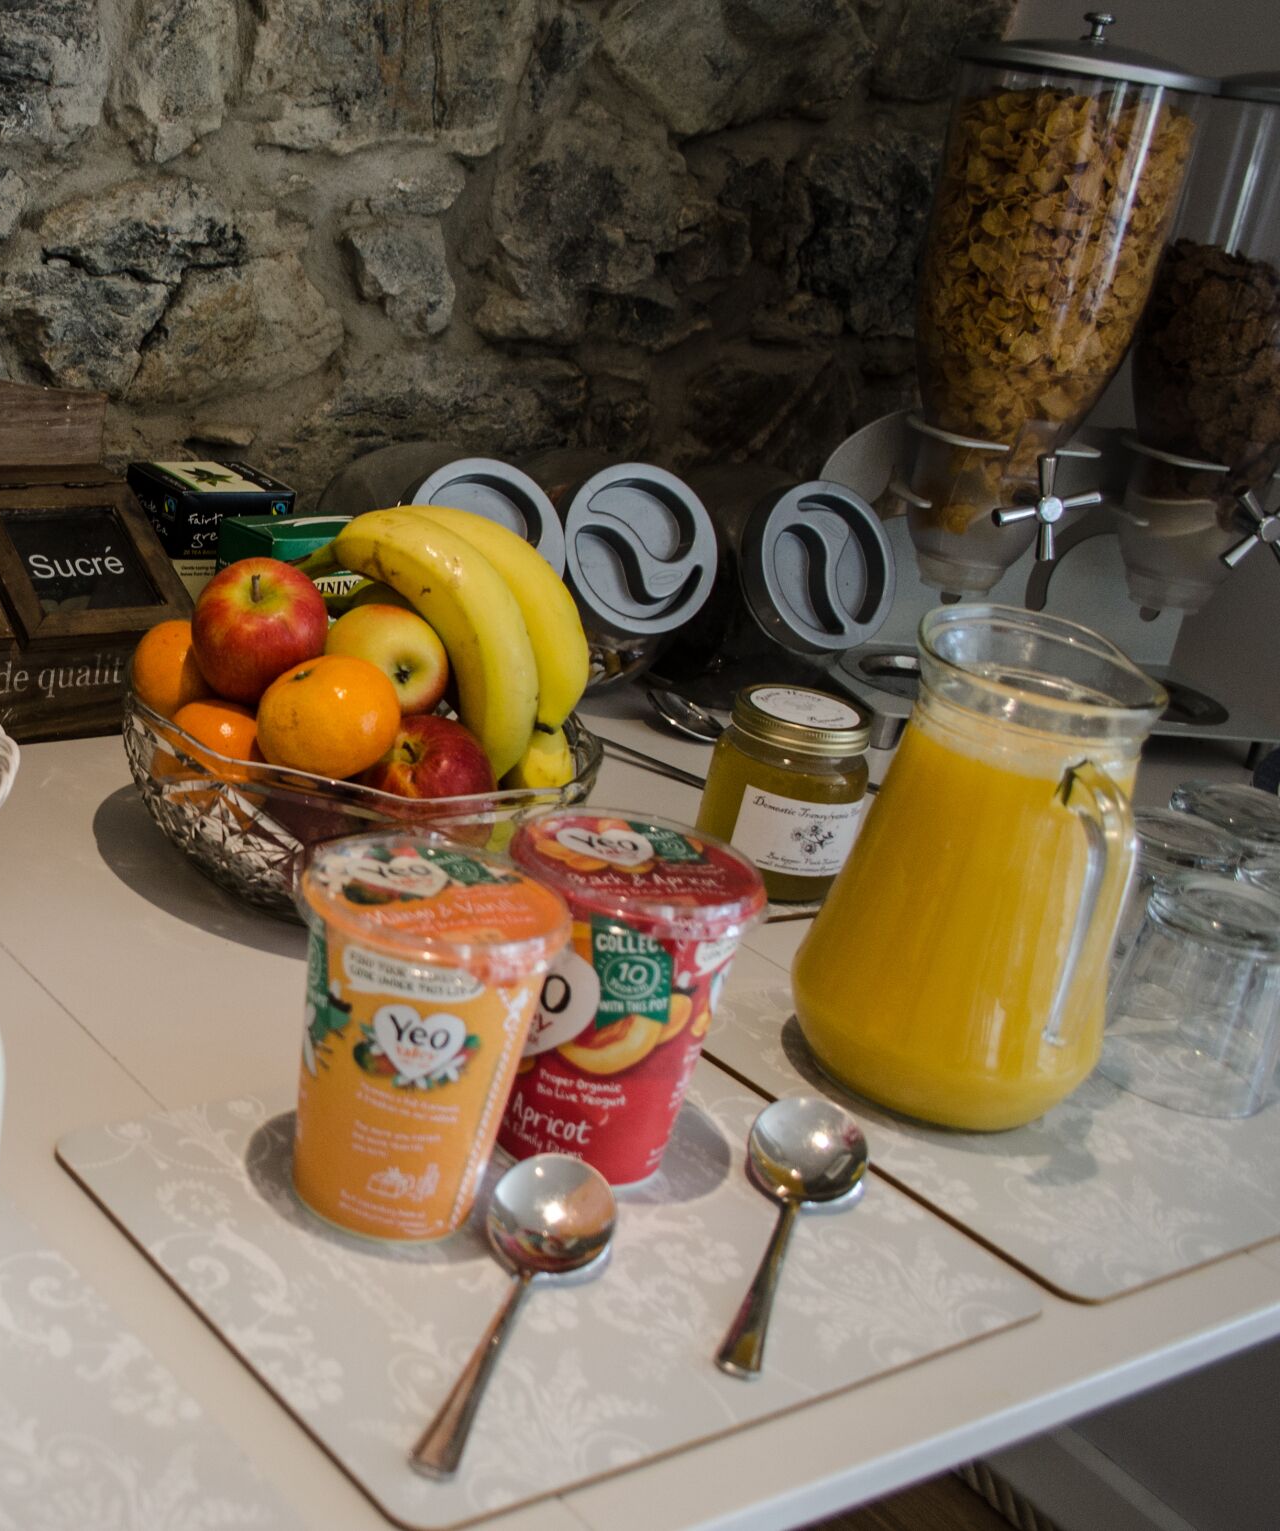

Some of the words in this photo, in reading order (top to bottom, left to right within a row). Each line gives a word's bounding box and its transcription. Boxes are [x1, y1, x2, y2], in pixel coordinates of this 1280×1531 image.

[190, 531, 219, 549] gre
[28, 545, 125, 579] Sucré
[567, 833, 640, 852] Yeo
[619, 962, 648, 984] 10
[626, 999, 648, 1012] THIS
[649, 998, 667, 1011] POT
[389, 1013, 451, 1050] Yeo
[536, 1082, 553, 1096] Bio
[555, 1085, 578, 1103] Live
[539, 1068, 575, 1088] Proper
[576, 1078, 623, 1095] Organic
[512, 1090, 593, 1145] Apricot
